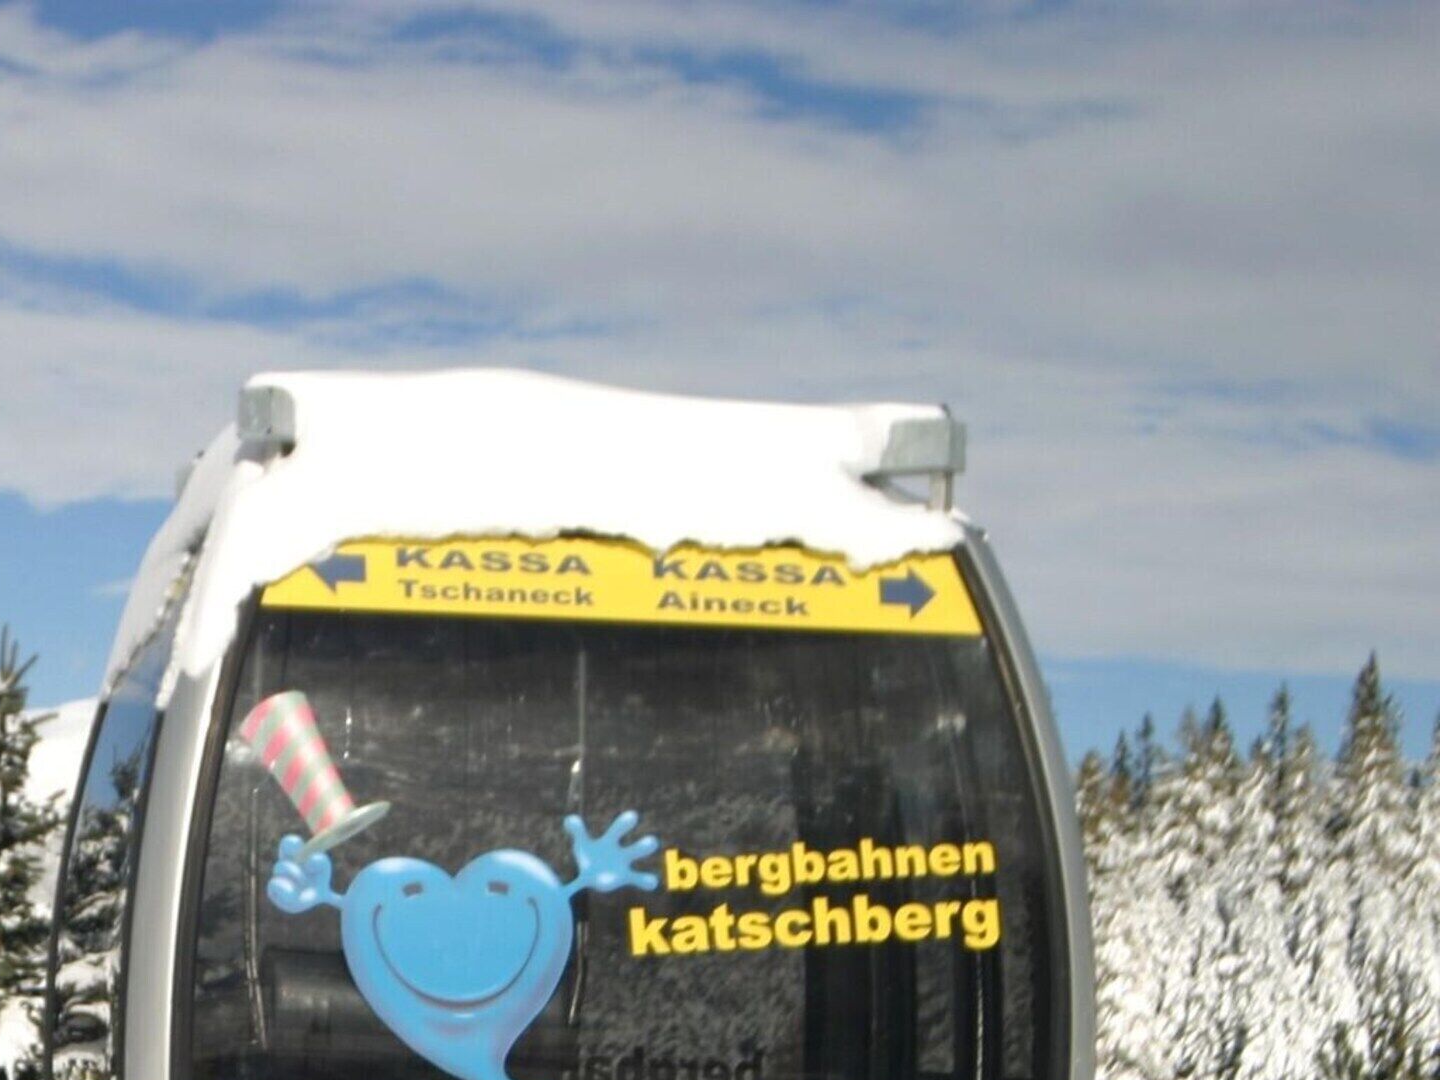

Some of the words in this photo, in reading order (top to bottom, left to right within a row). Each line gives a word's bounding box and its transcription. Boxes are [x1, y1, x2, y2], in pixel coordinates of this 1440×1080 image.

[395, 547, 592, 576] KASSA
[652, 556, 846, 586] KASSA
[398, 578, 594, 606] Tschaneck
[657, 590, 808, 616] Aineck
[665, 838, 996, 896] bergbahnen
[629, 894, 1001, 956] katschberg
